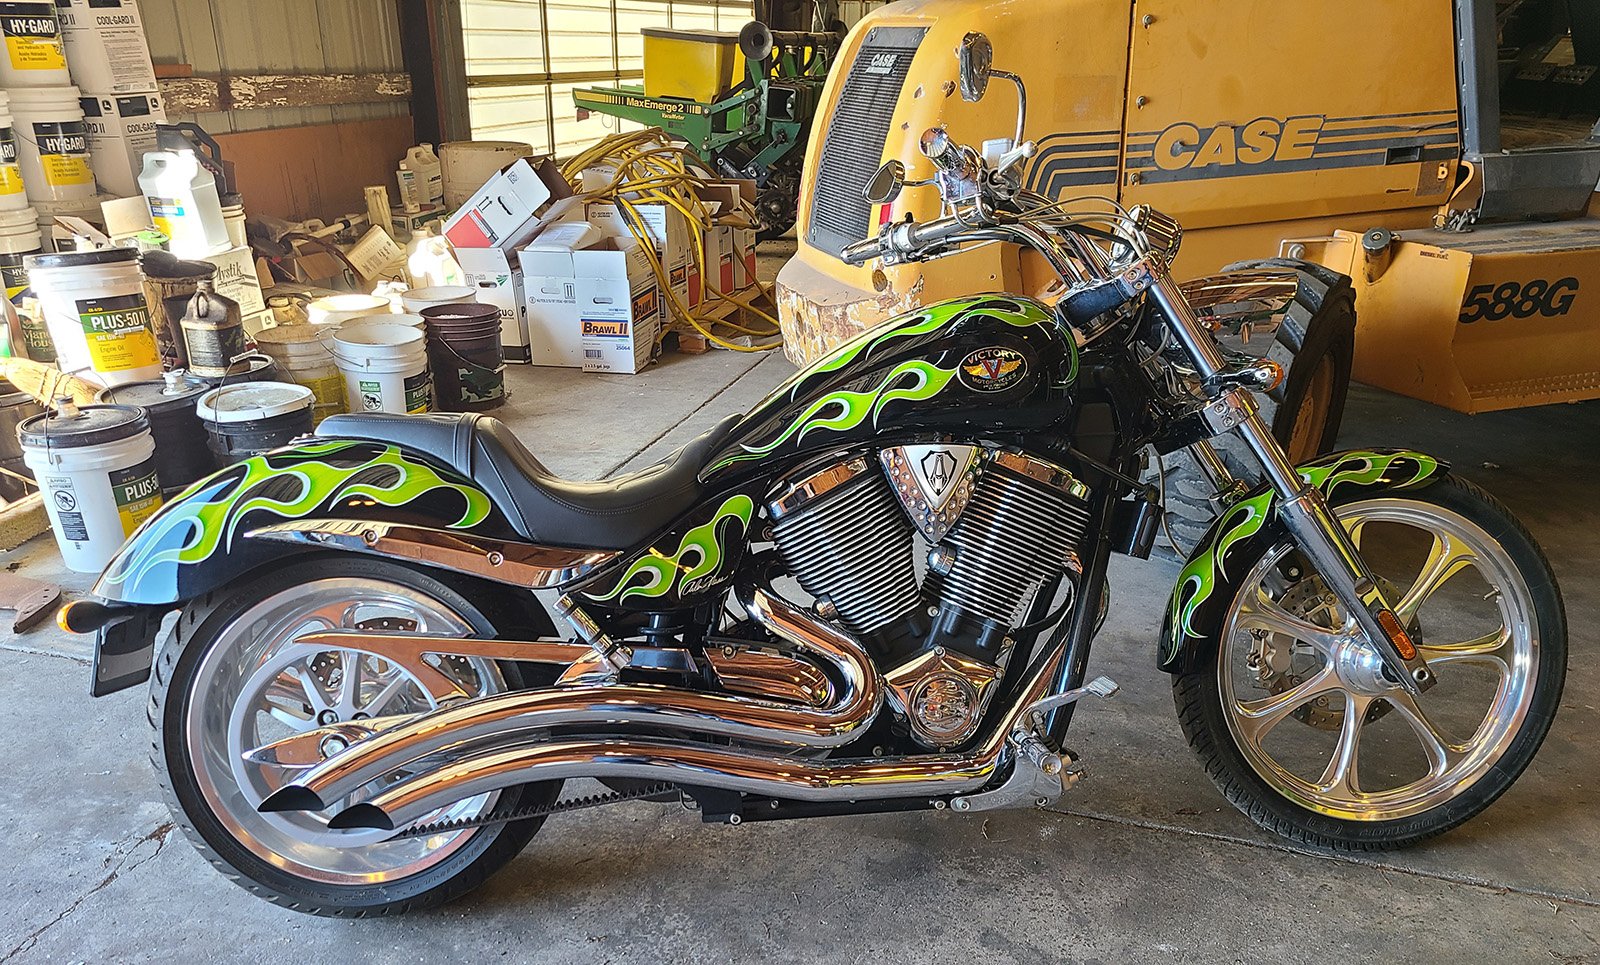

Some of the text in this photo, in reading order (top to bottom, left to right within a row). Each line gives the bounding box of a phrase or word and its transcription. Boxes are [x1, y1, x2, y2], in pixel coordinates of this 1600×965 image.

[10, 19, 55, 34] HY-GARD
[96, 15, 130, 25] COOL-GARD
[871, 53, 897, 67] CASE
[46, 136, 86, 152] HY-GARD
[1152, 115, 1327, 171] CASE
[1457, 276, 1580, 325] 588G
[91, 312, 139, 331] PLUS-50
[583, 322, 628, 334] BRAWL II
[967, 349, 1016, 364] VICTORY
